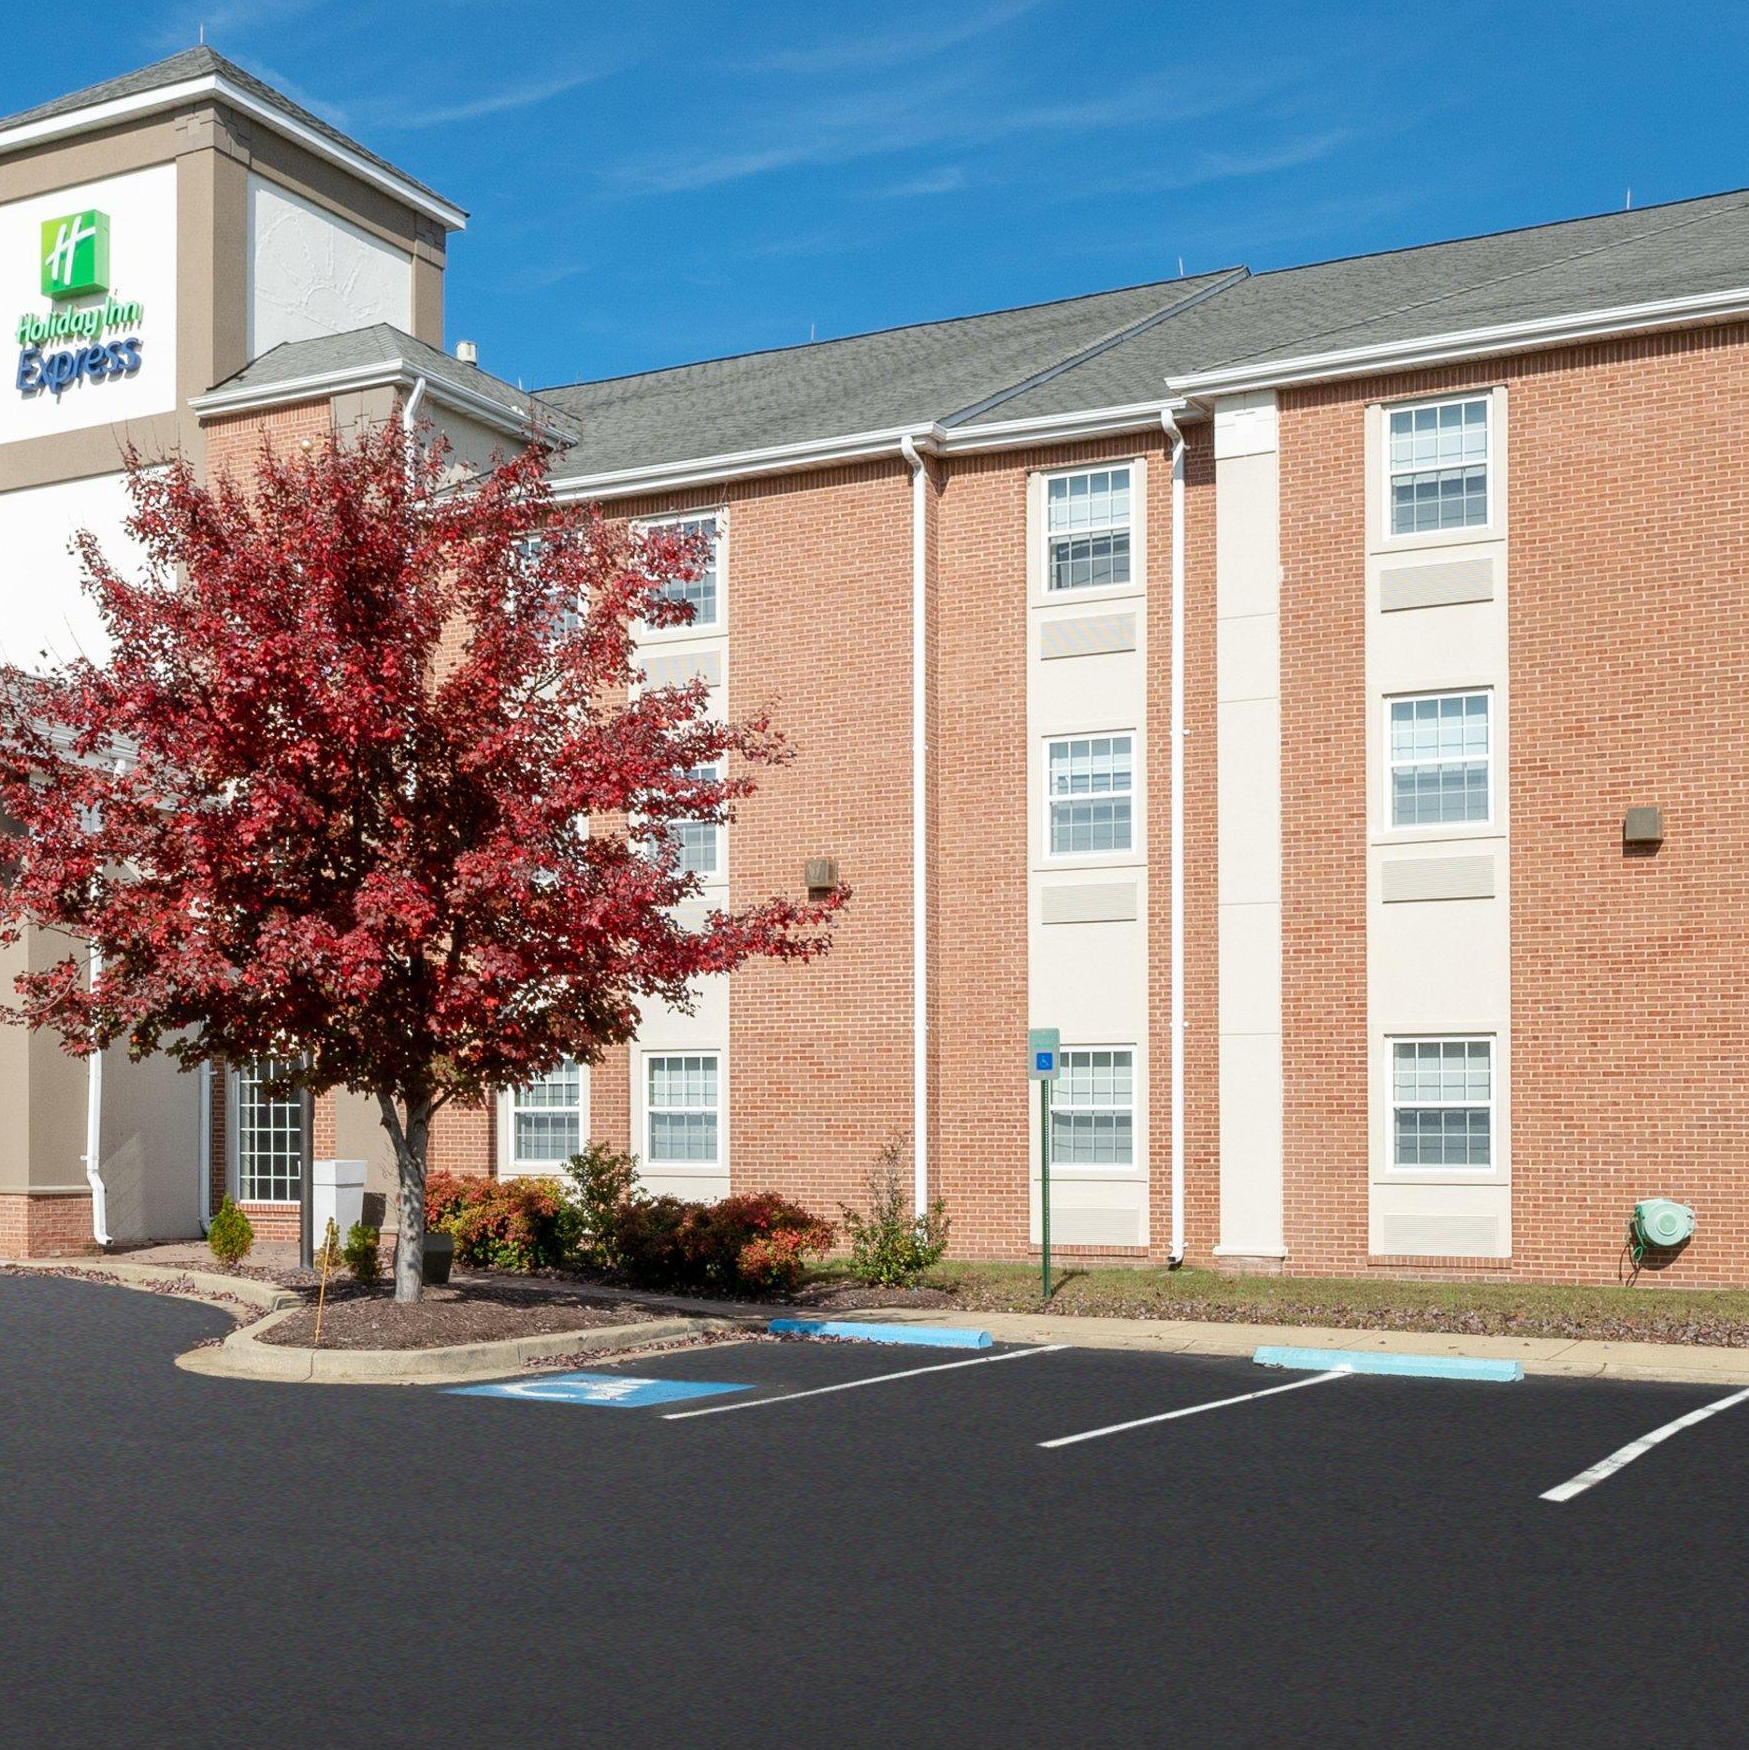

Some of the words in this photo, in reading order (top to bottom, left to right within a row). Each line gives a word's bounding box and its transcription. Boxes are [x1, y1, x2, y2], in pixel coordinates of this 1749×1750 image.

[45, 215, 96, 285] H
[16, 304, 100, 343] Holiday
[103, 295, 140, 327] Inn
[16, 337, 142, 395] Express
